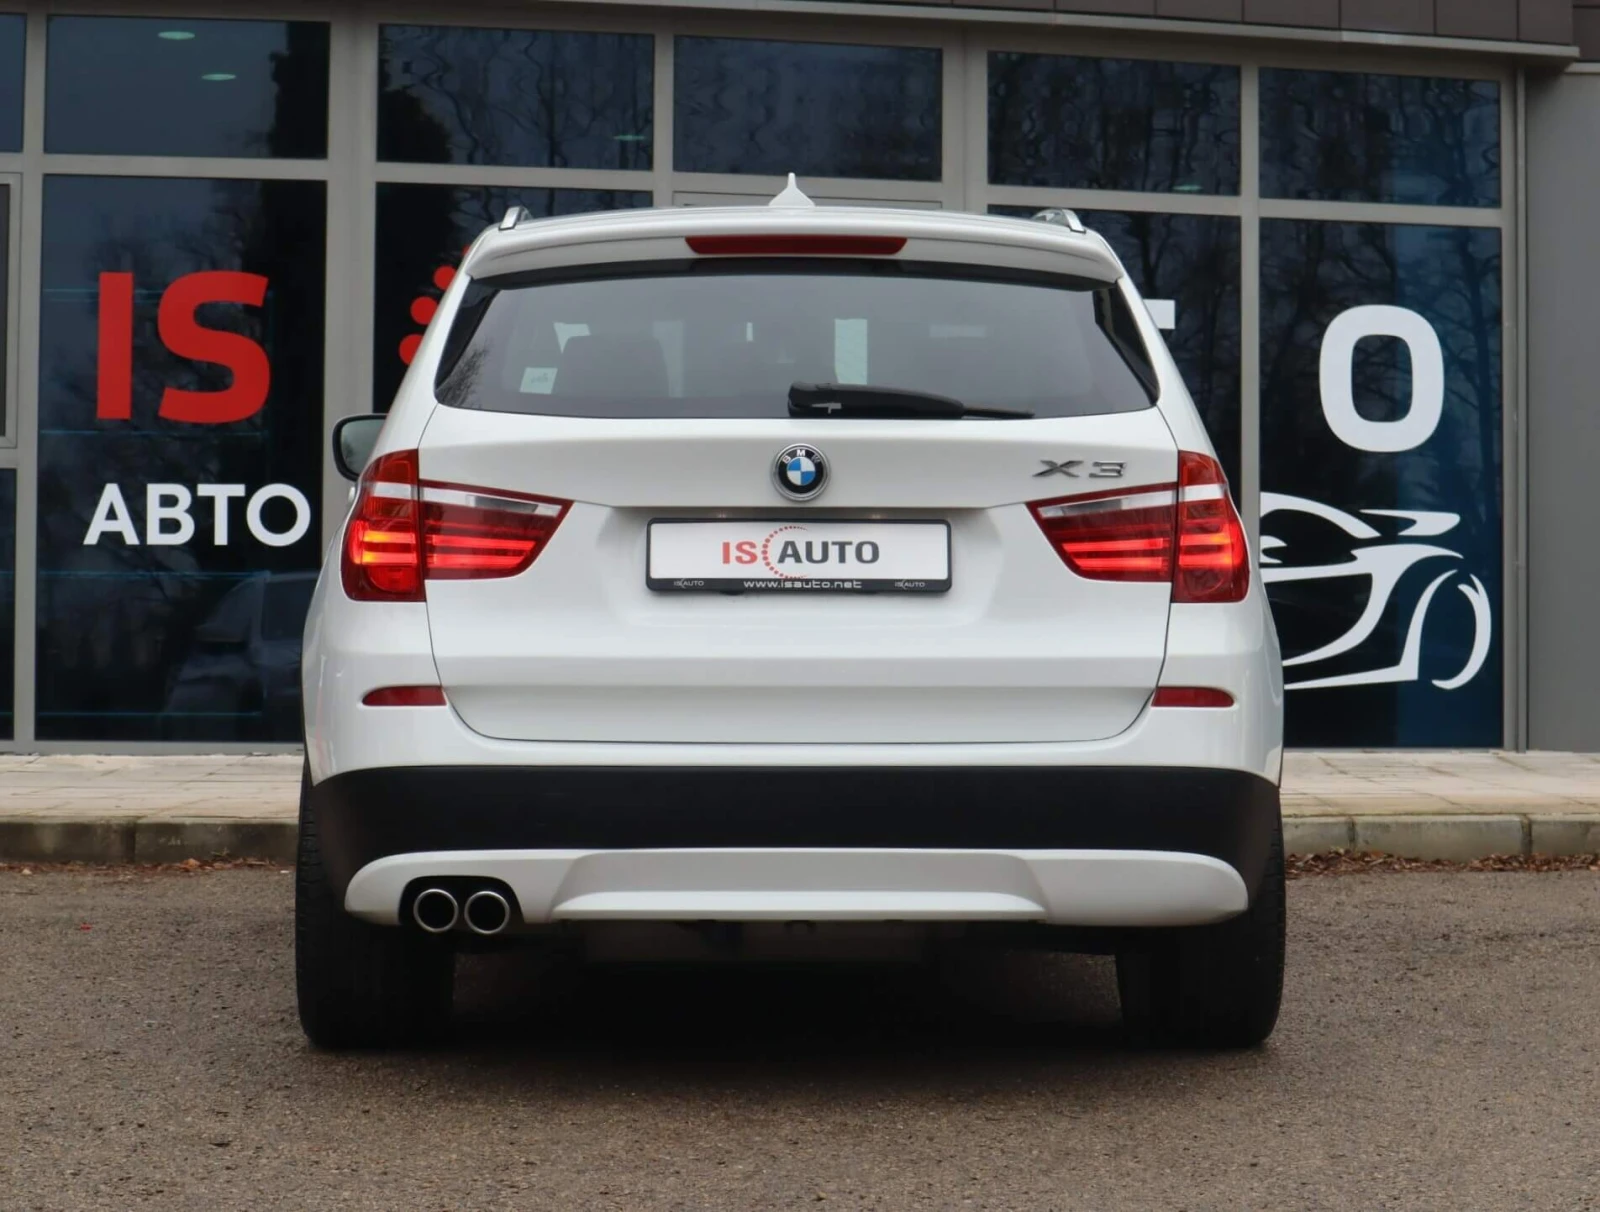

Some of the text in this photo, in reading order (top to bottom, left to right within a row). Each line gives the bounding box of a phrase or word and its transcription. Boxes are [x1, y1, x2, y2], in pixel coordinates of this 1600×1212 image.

[96, 271, 271, 423] IS
[782, 449, 821, 464] BMW
[1032, 460, 1127, 478] X3
[83, 483, 311, 547] АВТО
[722, 540, 880, 565] IS AUTO
[743, 580, 863, 589] www.isauto.net
